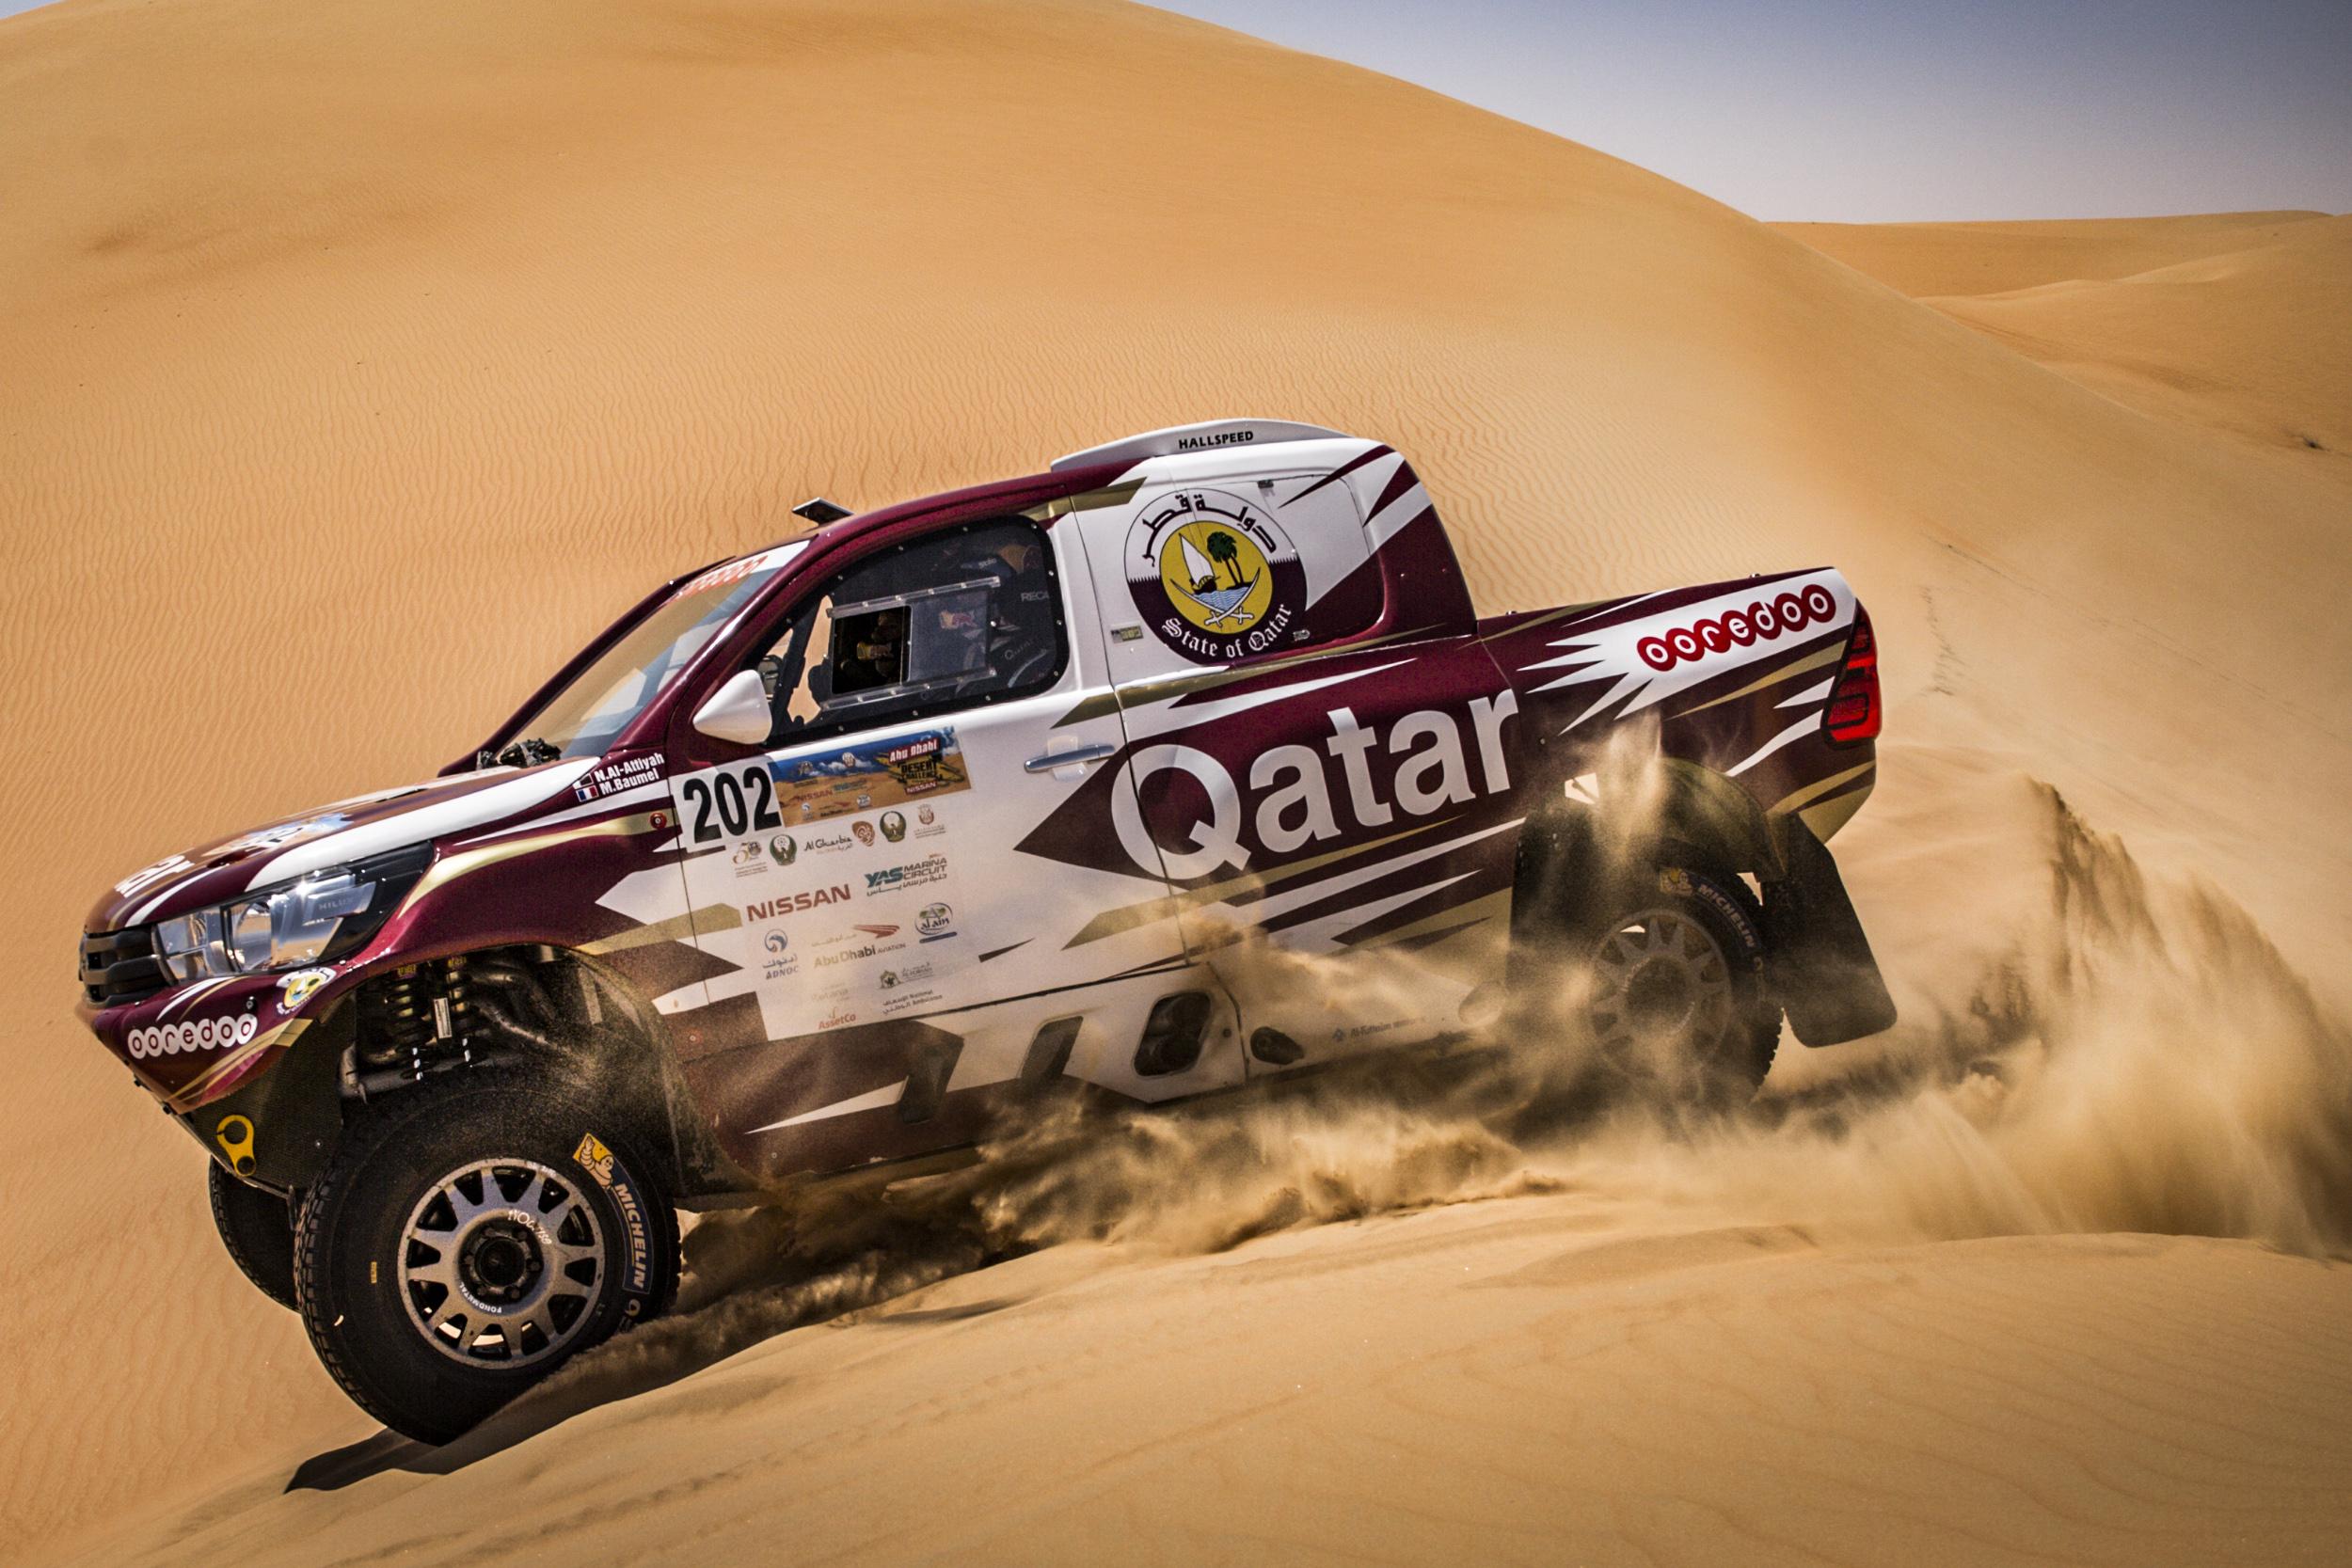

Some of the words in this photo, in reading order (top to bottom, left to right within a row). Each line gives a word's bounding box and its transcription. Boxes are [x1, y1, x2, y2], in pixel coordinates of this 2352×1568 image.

[1178, 431, 1254, 450] HALLSPEED
[1161, 617, 1218, 657] State
[1225, 641, 1245, 658] of
[1248, 603, 1292, 652] Qatar
[1643, 589, 1832, 664] ooredoo
[889, 749, 909, 763] Abu
[910, 738, 938, 756] Dhabi
[594, 752, 665, 784] N.Al-Attiyah
[598, 768, 660, 796] M.Baumel
[906, 782, 937, 794] NISSAN
[1111, 689, 1518, 880] Qatar
[683, 767, 783, 845] 202
[865, 866, 903, 888] YAS
[903, 857, 947, 872] MARINA
[903, 864, 947, 880] CIRCUIT
[746, 883, 851, 922] NISSAN
[1697, 882, 1756, 949] MICHELIN
[814, 954, 839, 969] Abu
[839, 944, 877, 963] Dhabi
[765, 965, 800, 980] ADNOC
[131, 1019, 254, 1053] ooredoo
[818, 1012, 857, 1030] AssetCo
[614, 1182, 647, 1290] MICHELIN
